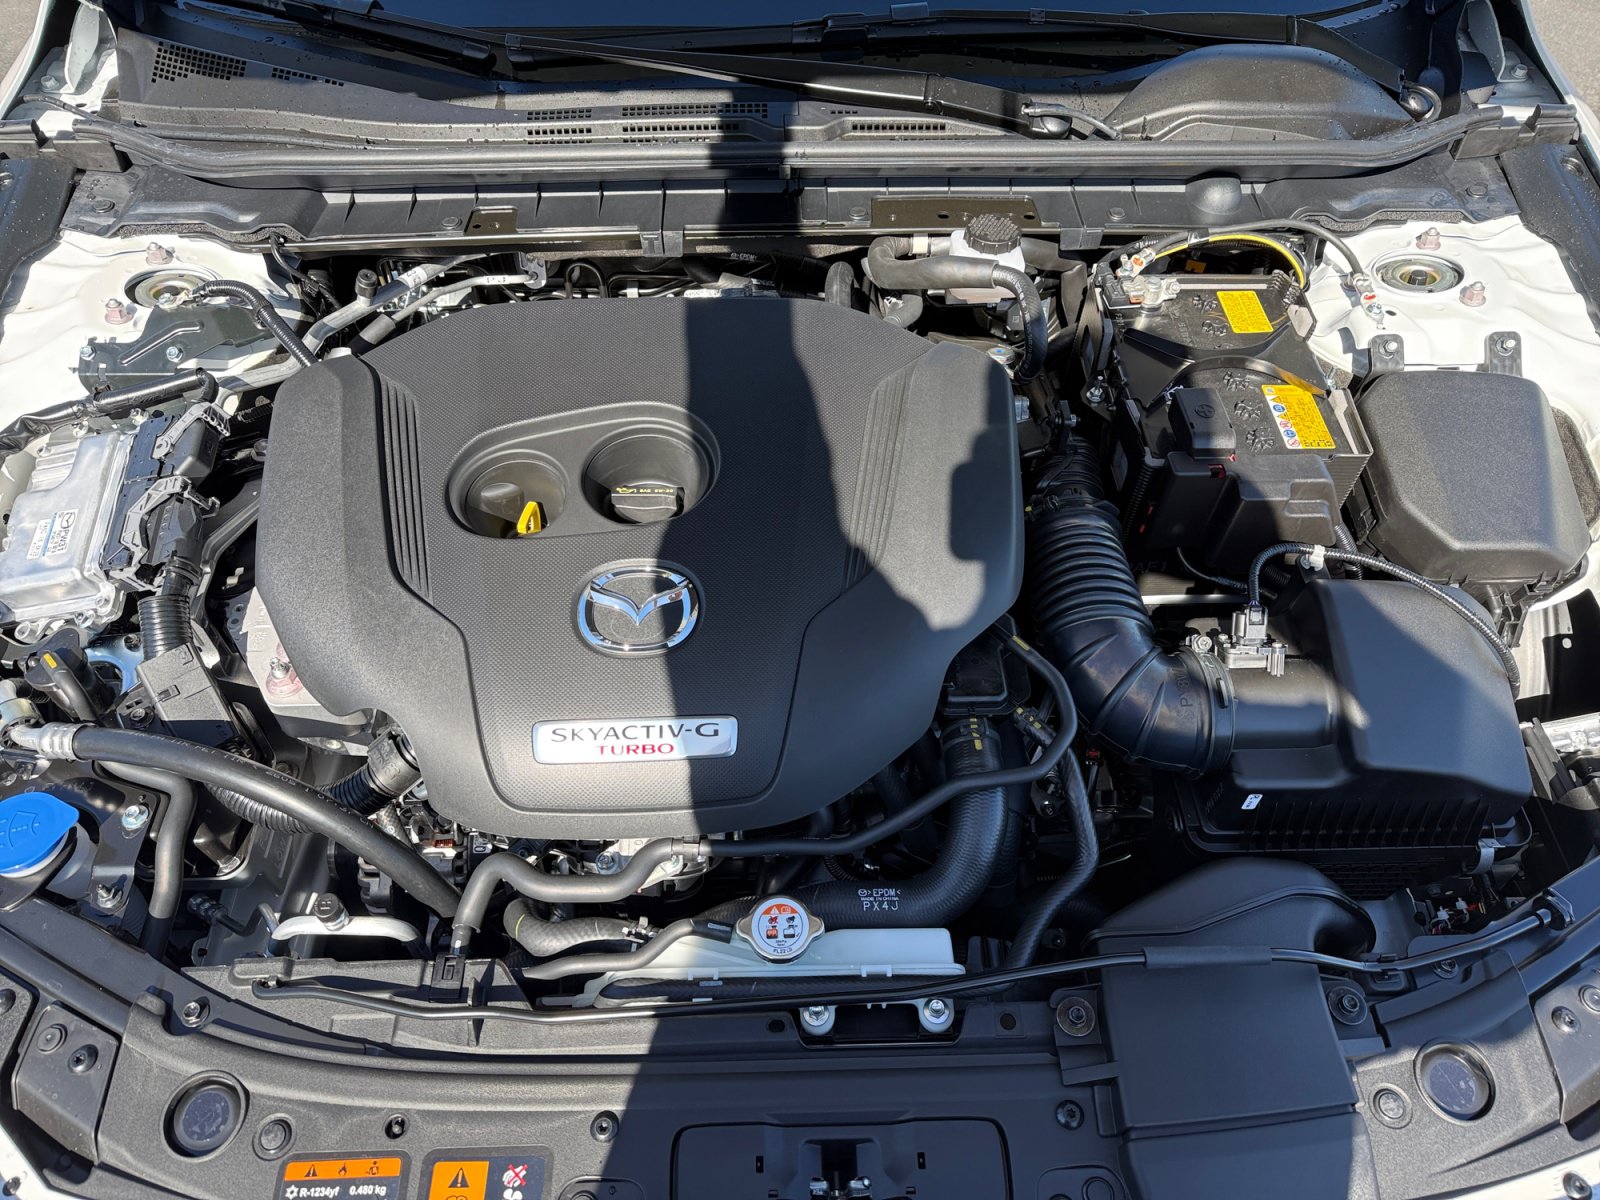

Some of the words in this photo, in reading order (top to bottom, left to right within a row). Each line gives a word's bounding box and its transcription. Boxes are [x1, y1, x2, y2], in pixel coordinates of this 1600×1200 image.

[551, 722, 720, 743] SKYACTIV-G
[596, 743, 675, 756] TURBO
[863, 900, 899, 912] PX4J
[299, 1185, 340, 1198] R-1234yf
[349, 1185, 374, 1196] 0.480
[374, 1185, 387, 1197] kg
